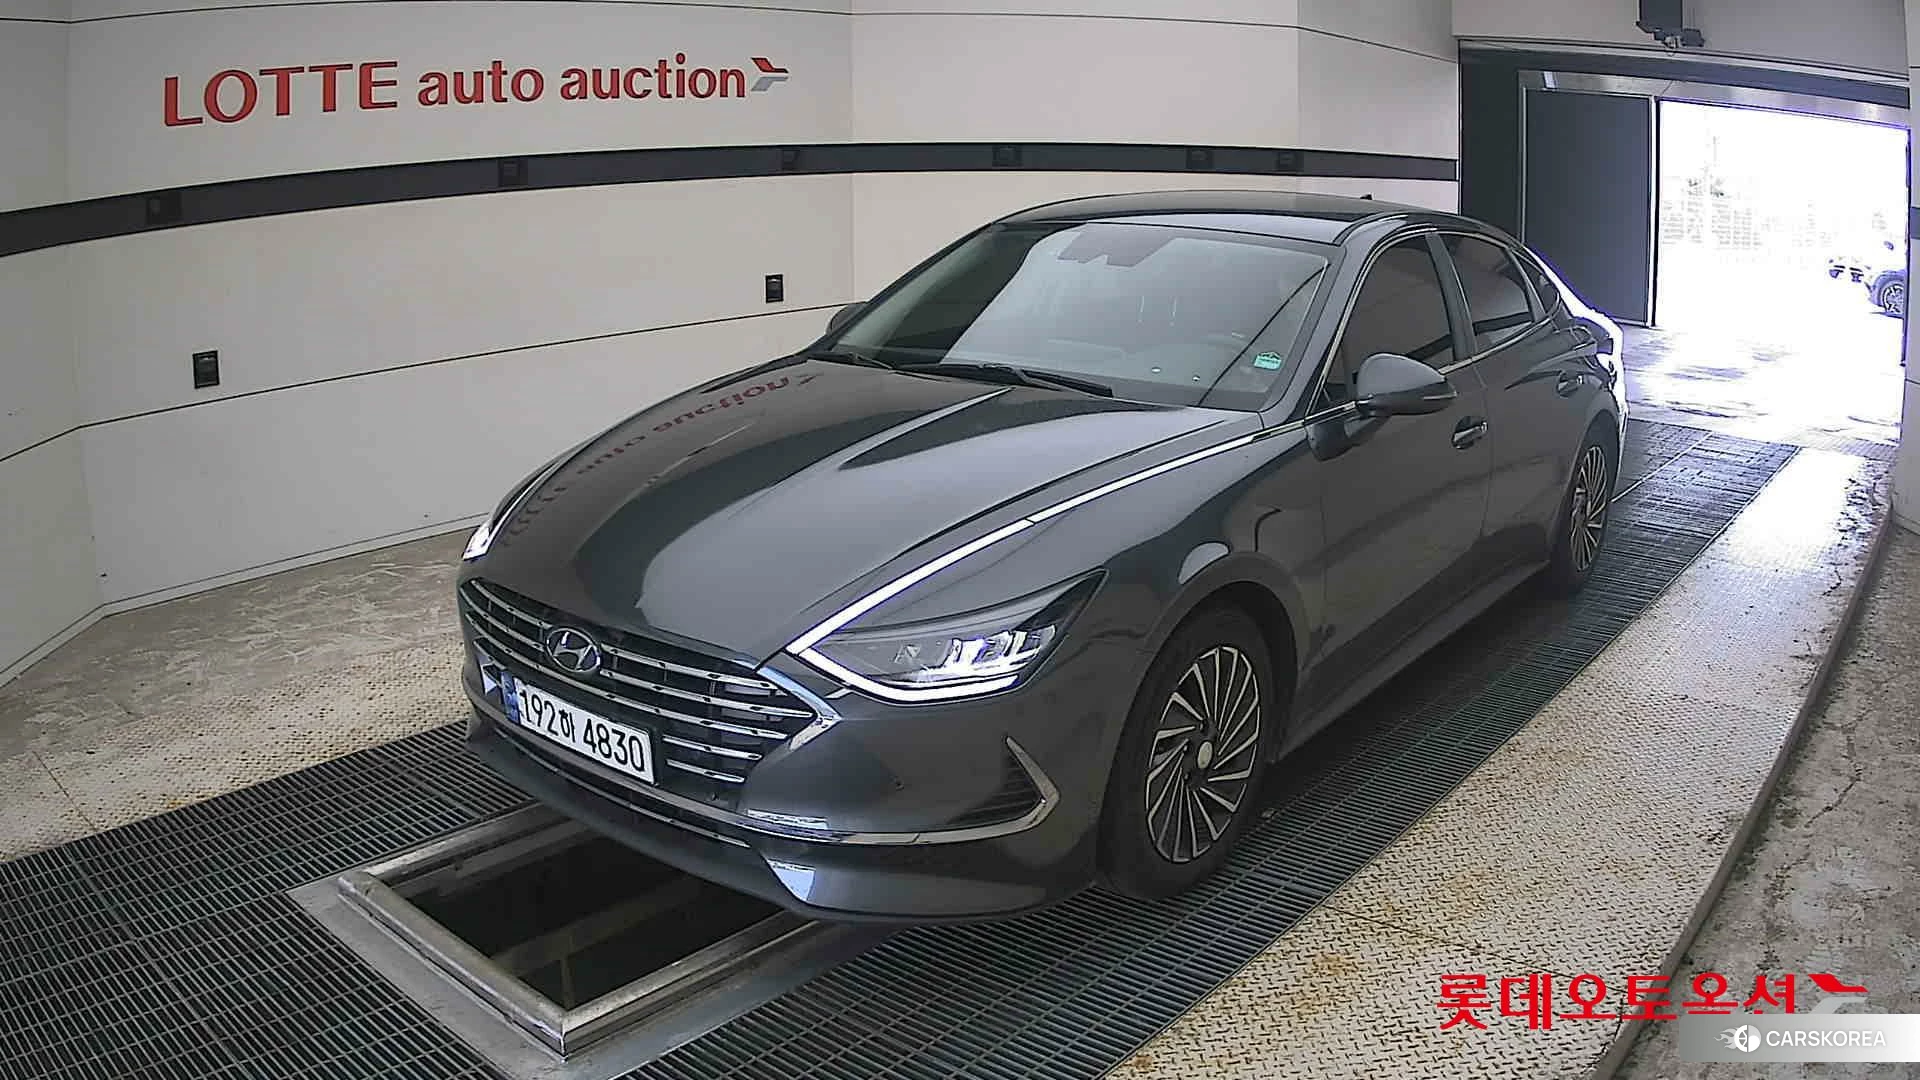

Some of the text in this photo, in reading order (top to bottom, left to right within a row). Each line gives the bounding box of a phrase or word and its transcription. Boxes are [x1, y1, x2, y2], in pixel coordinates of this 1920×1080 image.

[163, 53, 747, 127] LOTTE auto auction
[519, 689, 645, 772] 192하 4830
